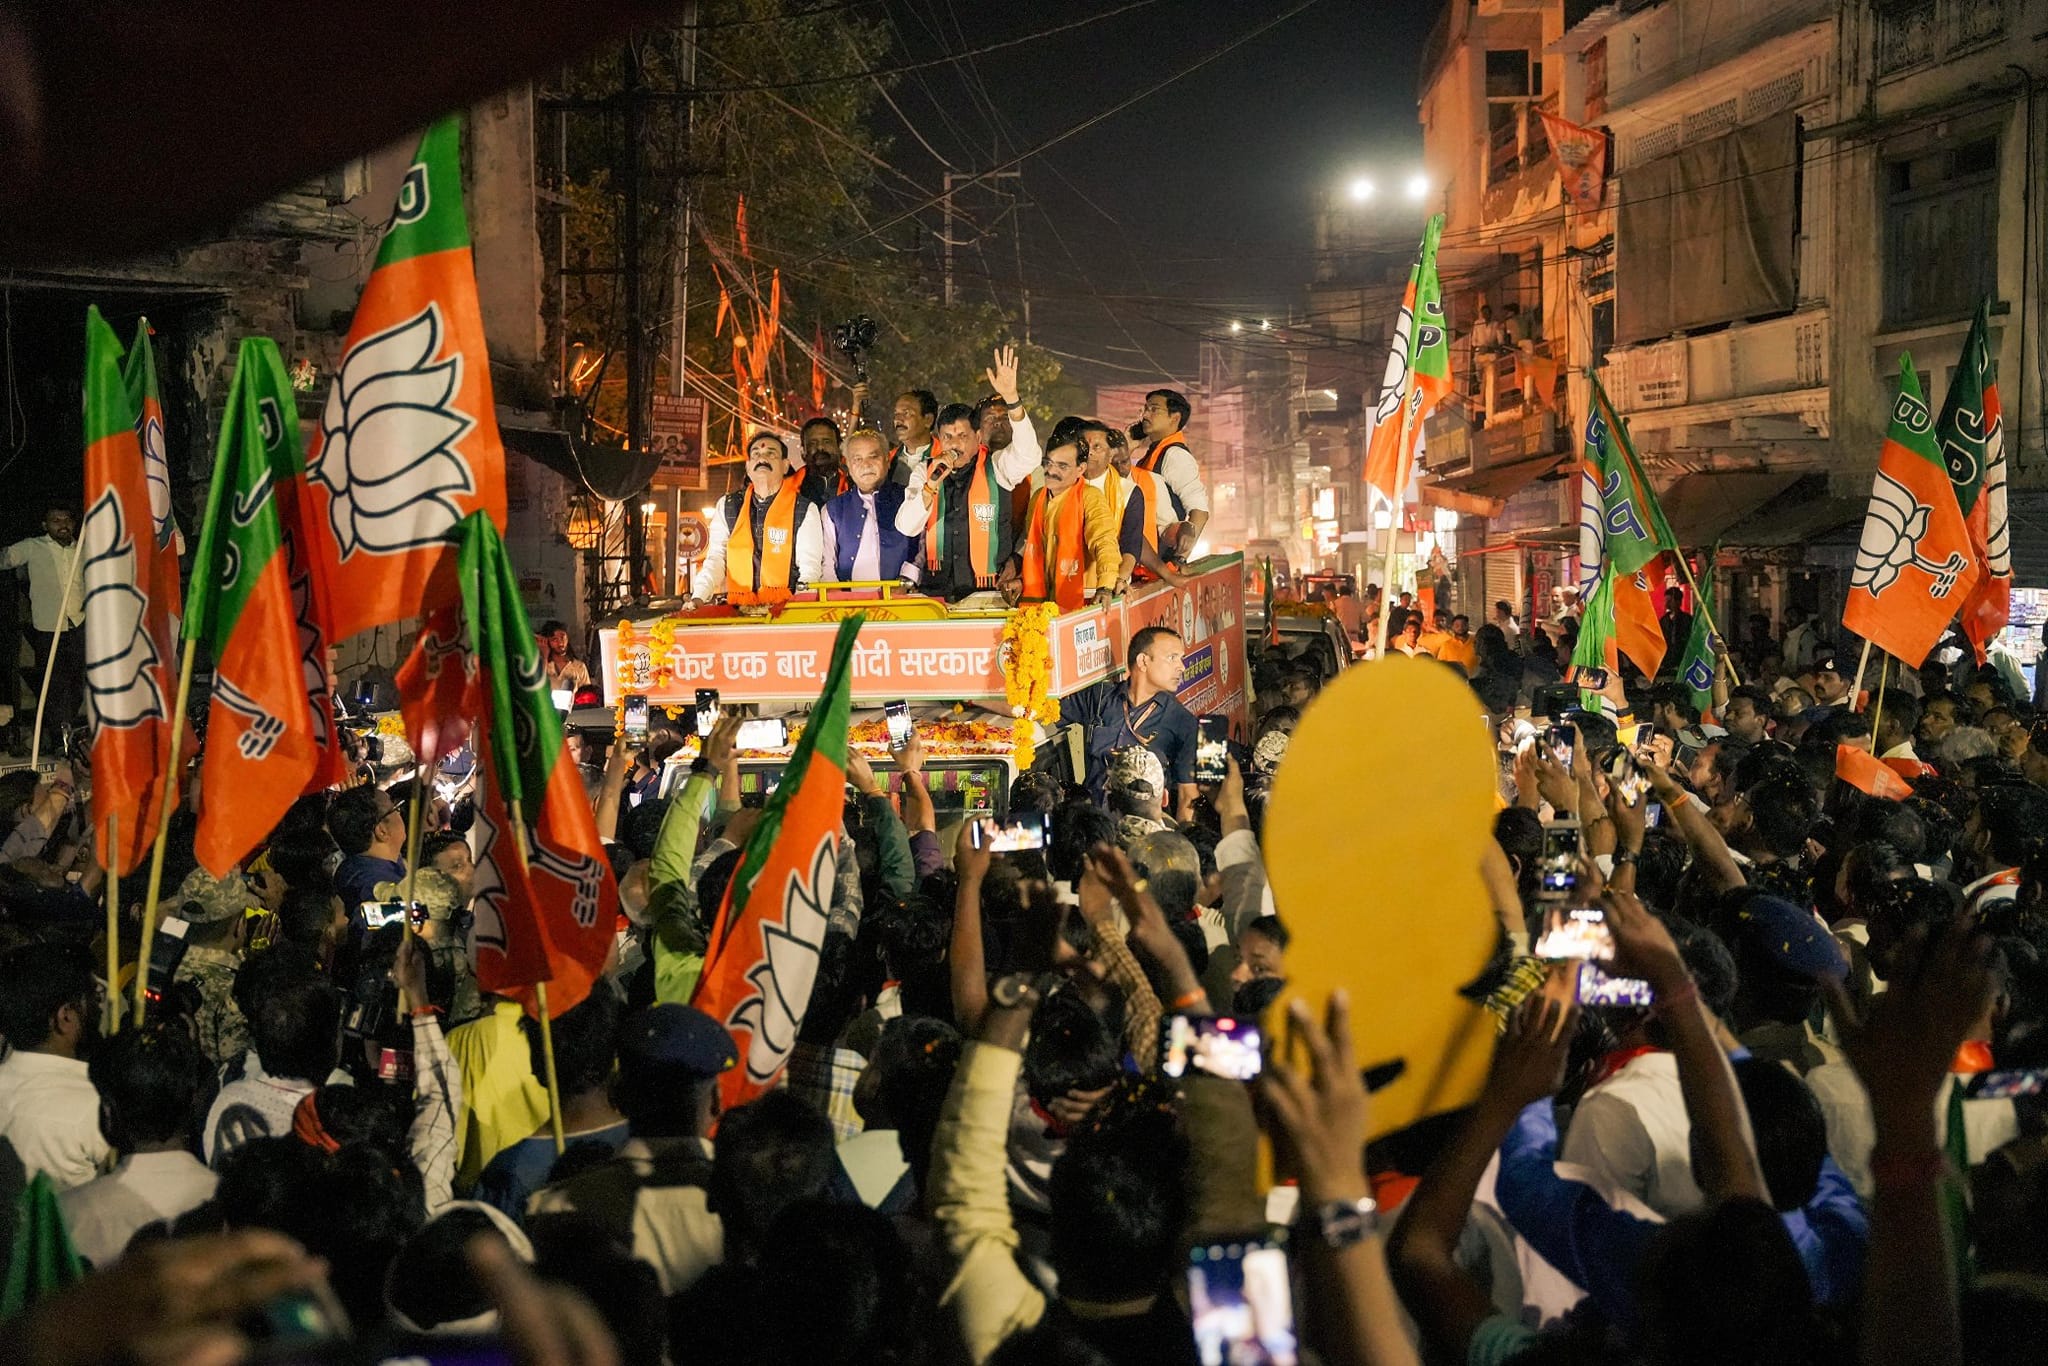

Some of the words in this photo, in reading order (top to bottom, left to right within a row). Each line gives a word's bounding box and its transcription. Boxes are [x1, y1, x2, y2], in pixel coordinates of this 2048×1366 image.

[721, 651, 768, 679] एक
[850, 638, 892, 677] ोदी
[898, 647, 991, 677] सरकार
